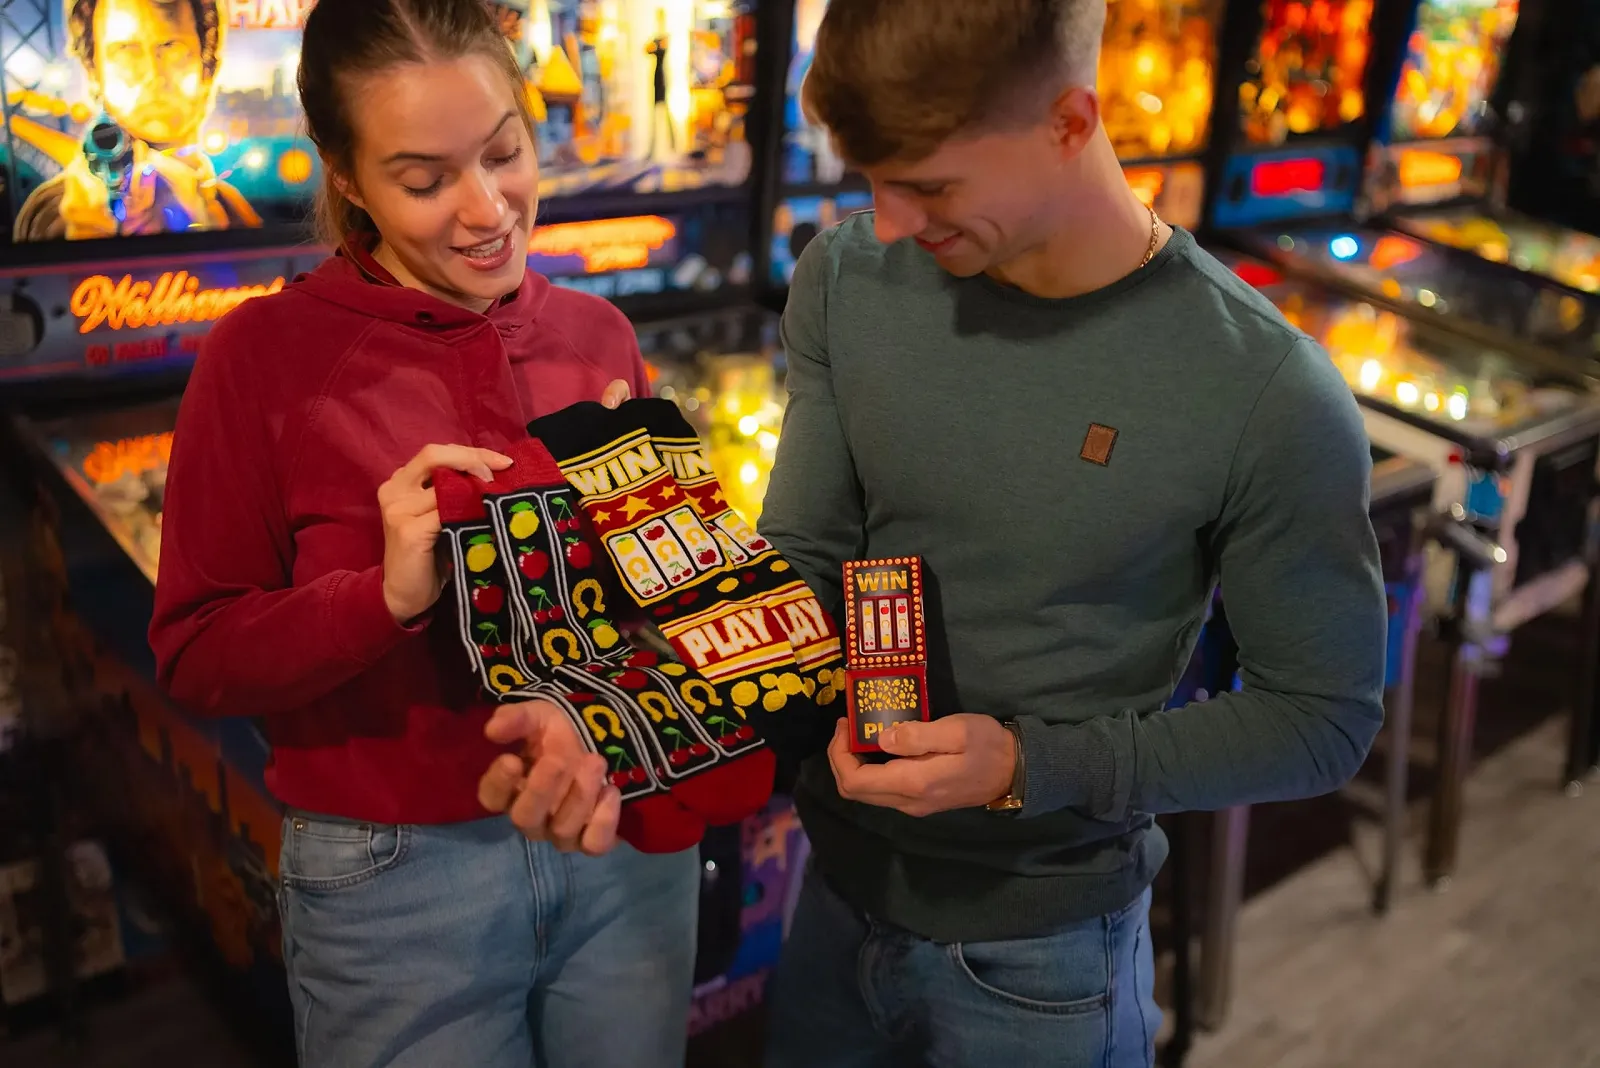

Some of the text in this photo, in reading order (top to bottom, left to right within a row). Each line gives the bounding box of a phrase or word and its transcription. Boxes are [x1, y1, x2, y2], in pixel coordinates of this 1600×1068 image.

[564, 441, 662, 496] WIN
[856, 570, 908, 592] WIN
[678, 607, 773, 668] PLAY
